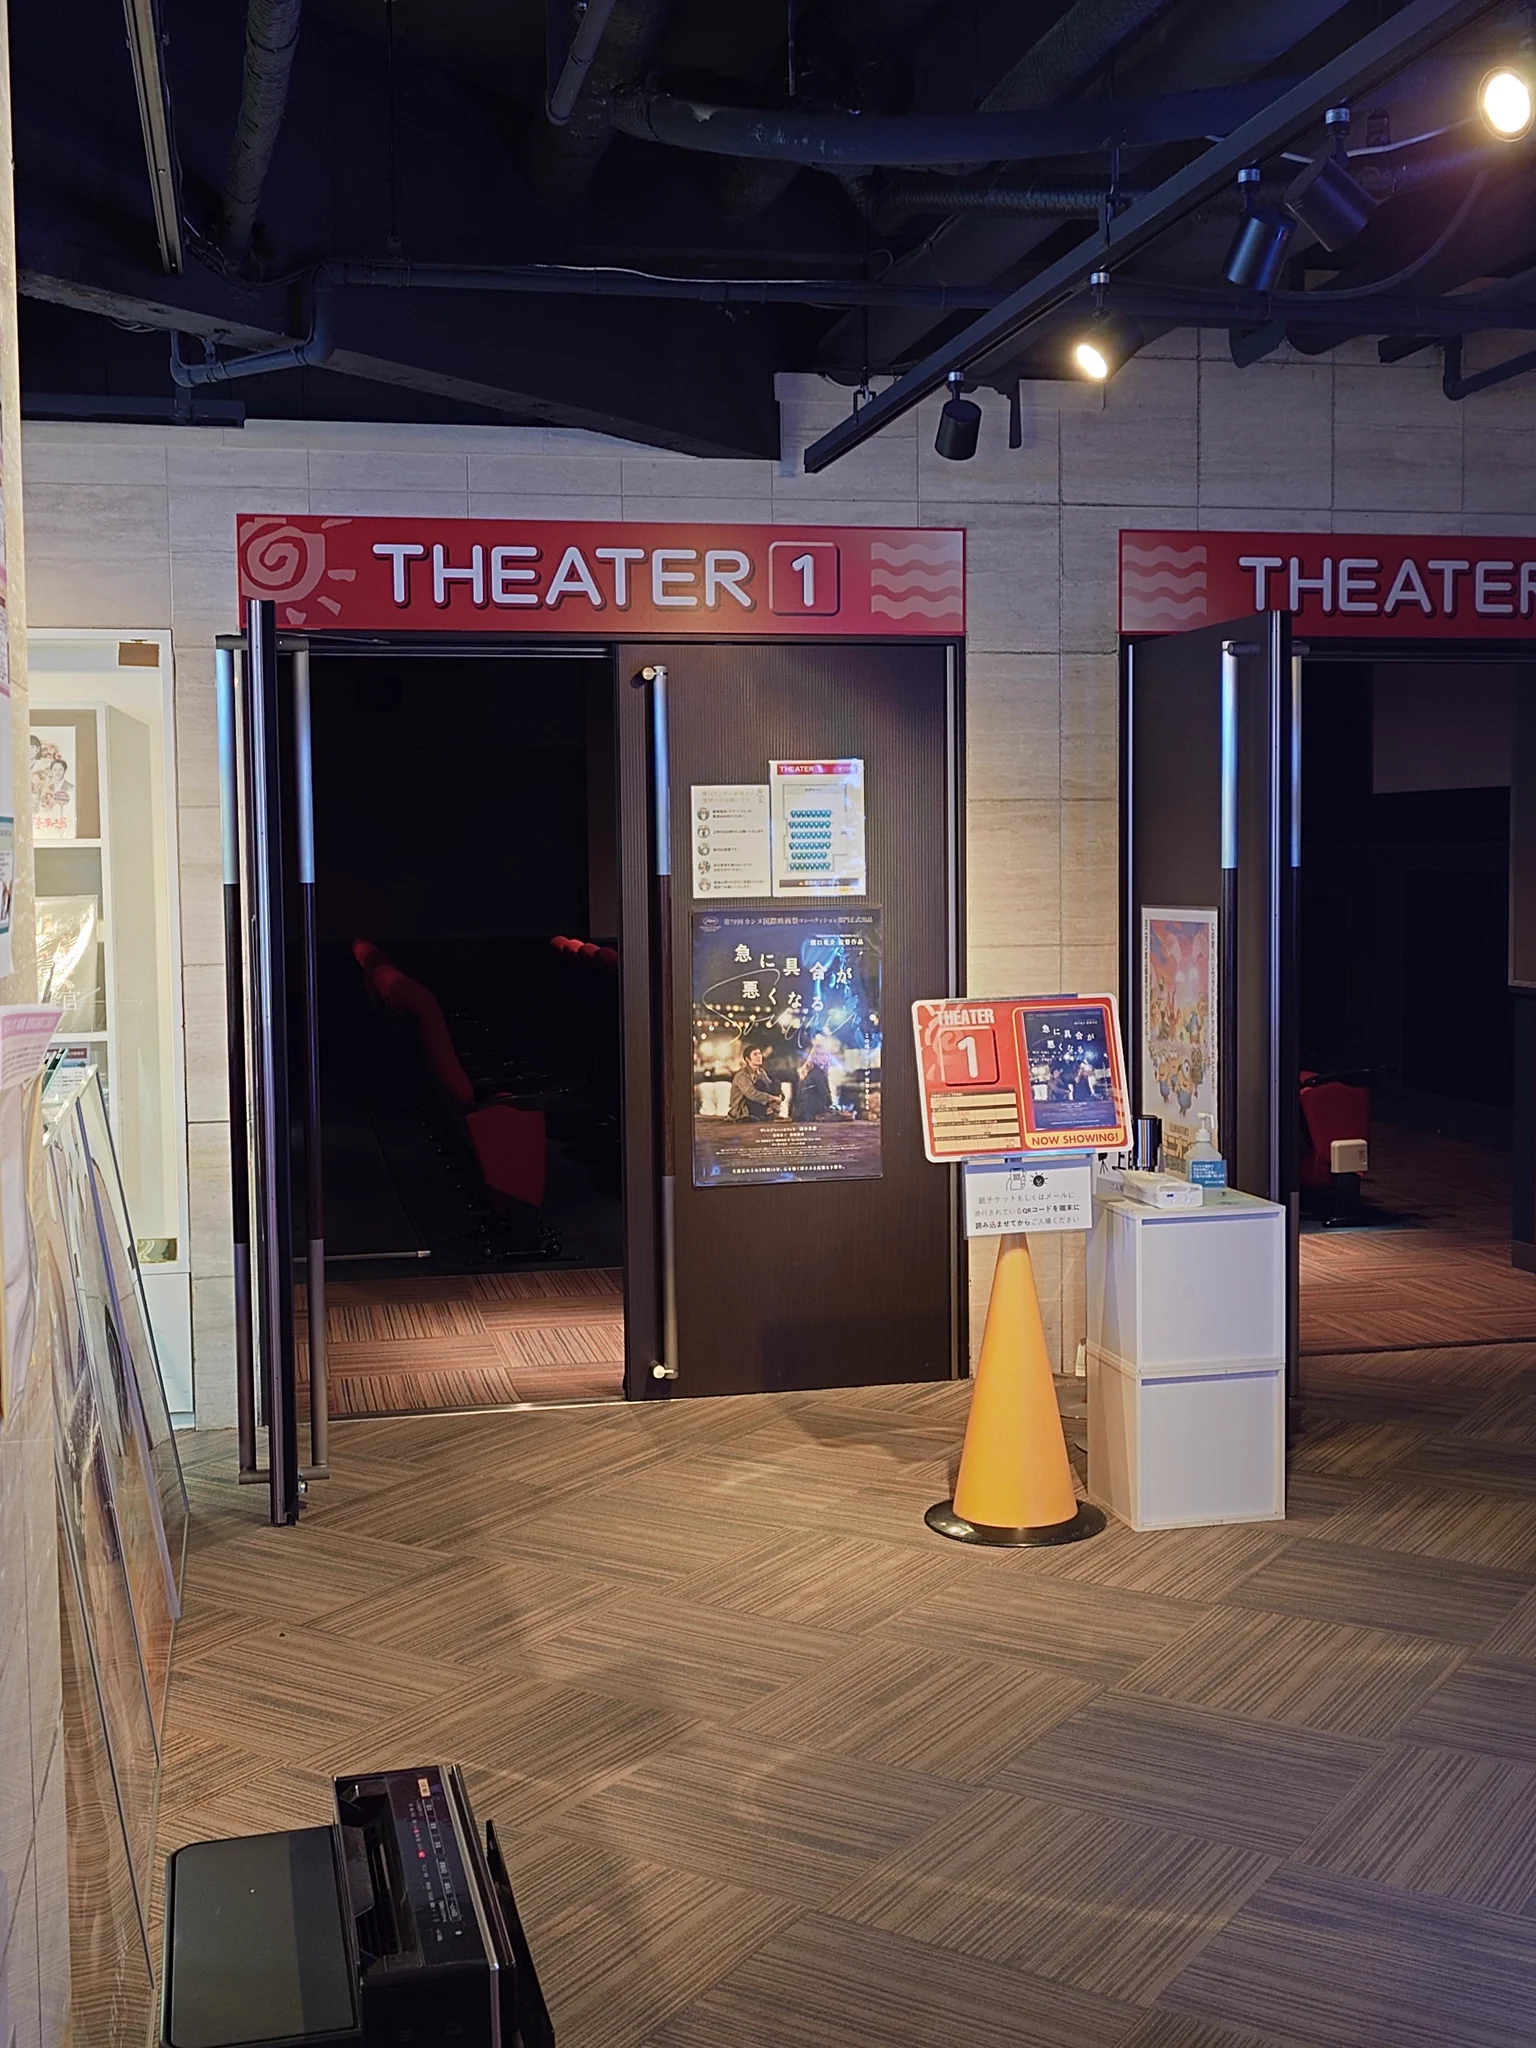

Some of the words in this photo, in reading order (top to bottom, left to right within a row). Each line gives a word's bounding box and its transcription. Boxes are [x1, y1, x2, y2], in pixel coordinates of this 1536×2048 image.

[372, 543, 753, 607] THEATER
[792, 553, 815, 607] 1
[779, 765, 815, 773] THEATER
[742, 980, 824, 1011] 悪くなる
[935, 1008, 995, 1026] THEATER
[957, 1034, 979, 1079] 1
[1032, 1135, 1059, 1146] NOW
[1063, 1132, 1119, 1144] SHOWING!
[978, 1192, 1075, 1204] 紙チケットもしくはメールに
